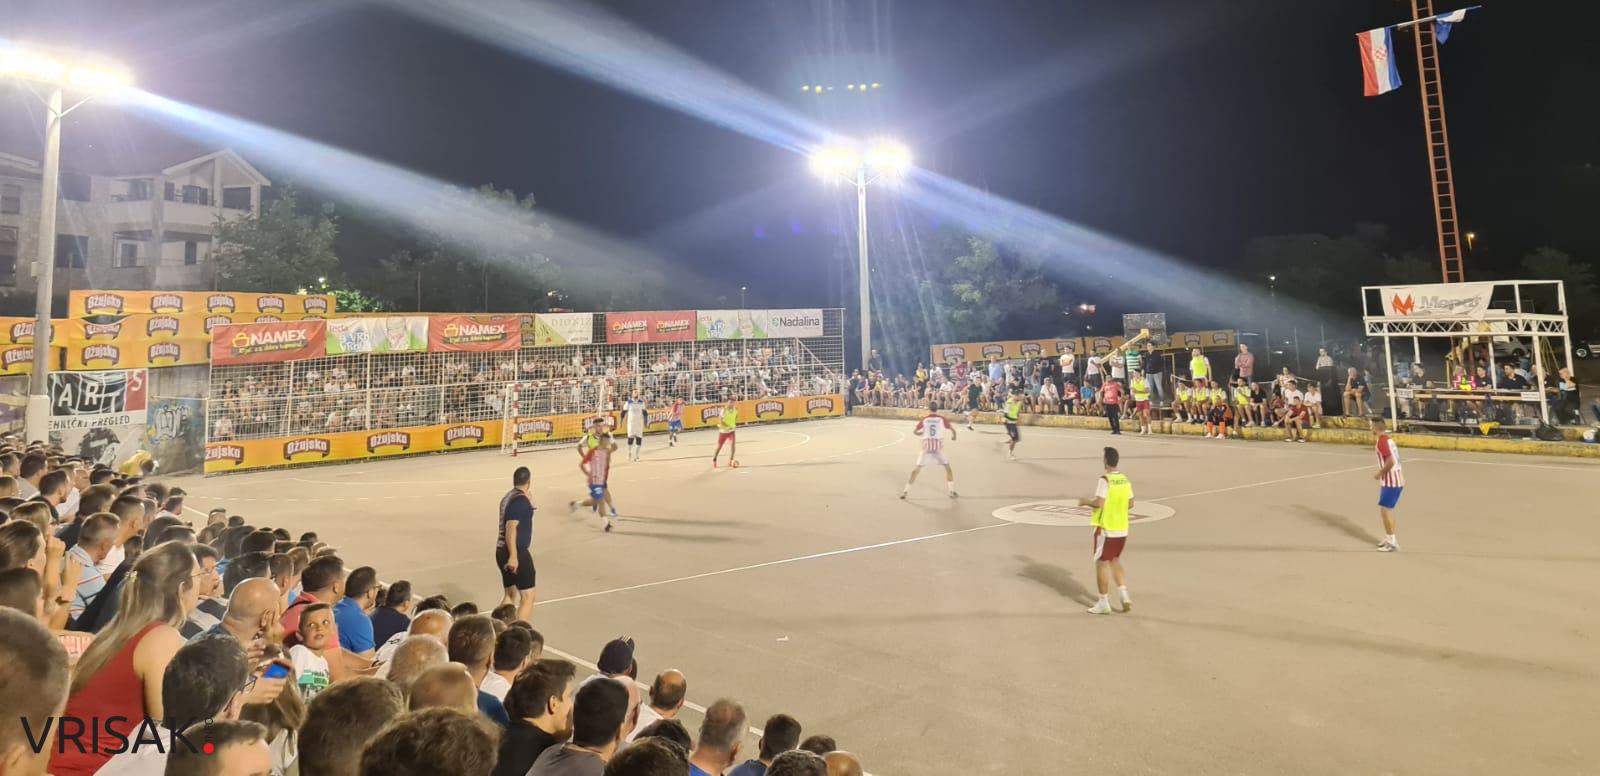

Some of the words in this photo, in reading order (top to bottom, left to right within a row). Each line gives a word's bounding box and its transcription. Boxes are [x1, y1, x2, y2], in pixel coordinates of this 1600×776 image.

[779, 316, 820, 327] Nadalina
[459, 323, 505, 336] NAMEX
[250, 328, 307, 346] NAMEX
[447, 426, 481, 441] Ožujsko
[929, 424, 936, 437] 6
[287, 438, 327, 454] Ožujsko
[370, 432, 407, 447] Ožujsko
[205, 445, 241, 459] žujsko
